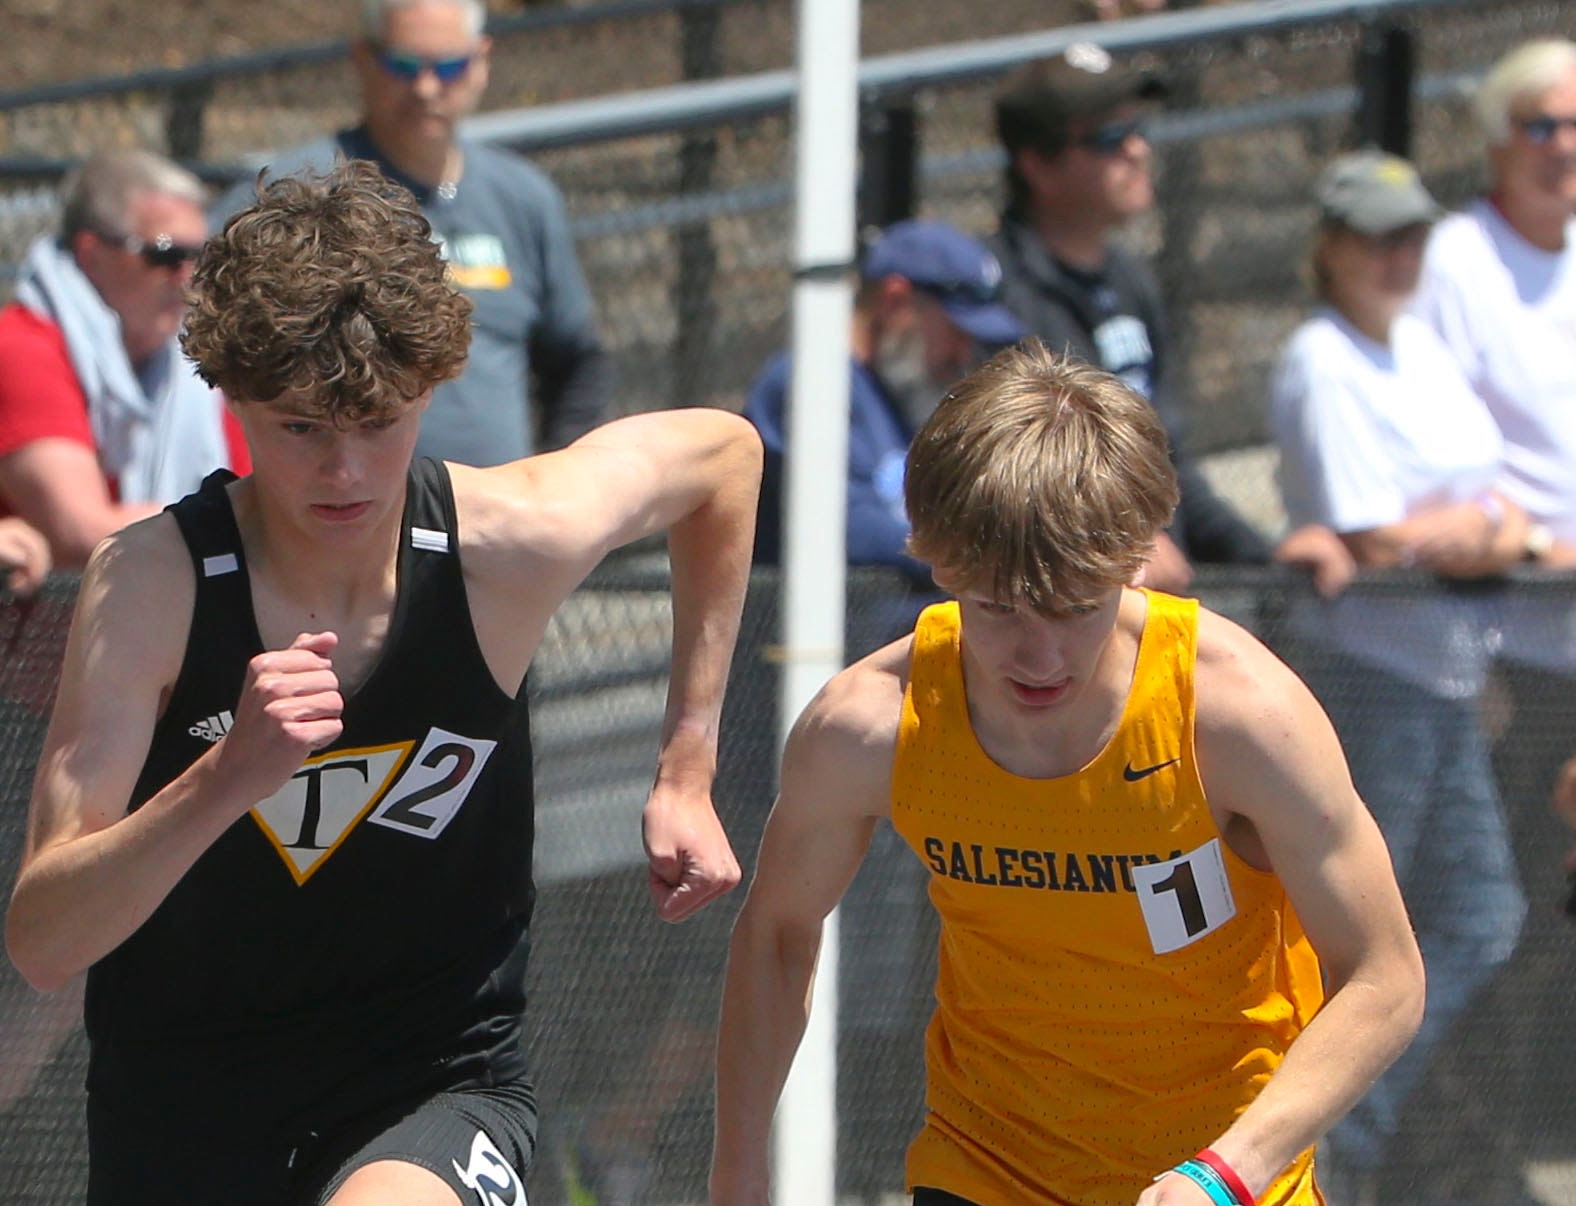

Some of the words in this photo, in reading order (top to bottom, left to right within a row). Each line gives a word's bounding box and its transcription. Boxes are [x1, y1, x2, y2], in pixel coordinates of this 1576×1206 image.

[380, 742, 476, 830] 2
[924, 836, 1183, 894] SALESIANU
[1151, 860, 1208, 938] 1
